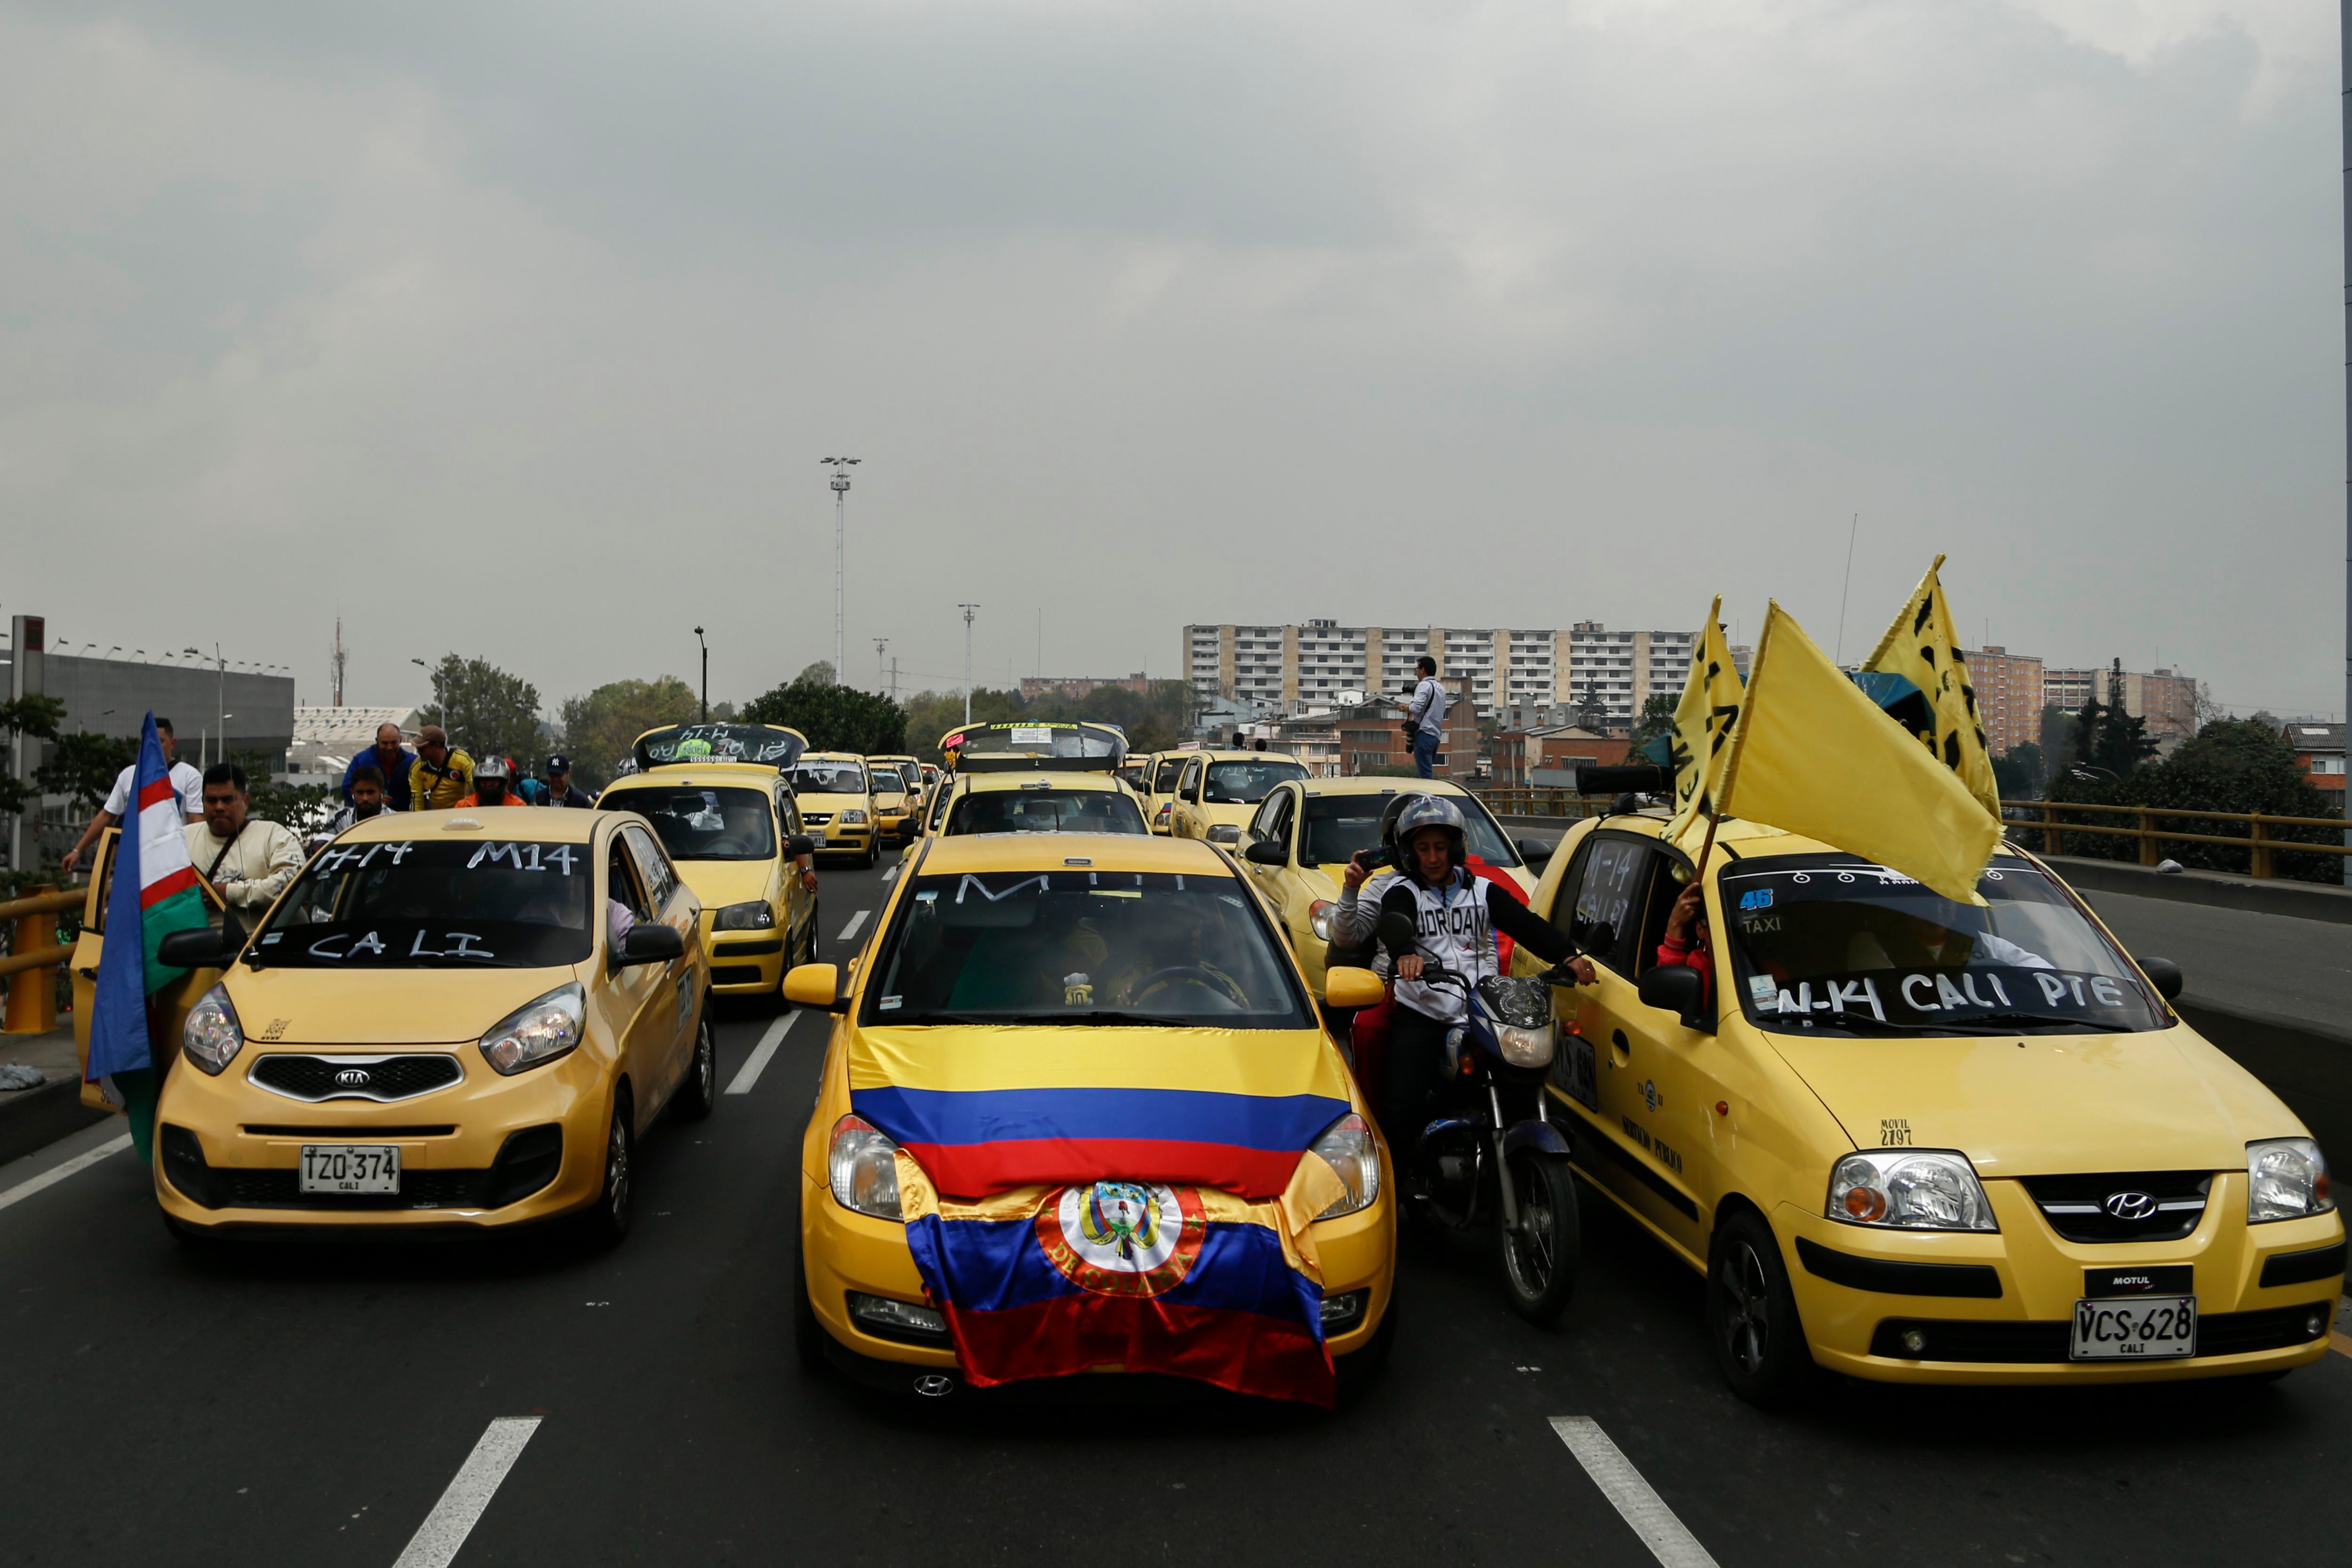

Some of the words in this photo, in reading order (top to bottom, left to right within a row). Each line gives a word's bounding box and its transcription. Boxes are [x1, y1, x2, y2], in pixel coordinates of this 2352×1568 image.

[467, 841, 579, 875] M14
[1740, 888, 1773, 911] 46
[1416, 907, 1486, 937] JORDAN
[1742, 916, 1782, 934] TAXI
[308, 930, 494, 959] CALI
[1072, 992, 1083, 1005] 10
[1902, 972, 2011, 1011] CALI
[2033, 971, 2123, 1007] PTE
[340, 1073, 364, 1083] KIA
[1881, 1119, 1909, 1130] MOVIL
[1880, 1129, 1913, 1146] 2197
[1049, 1241, 1080, 1275] DE
[2113, 1276, 2150, 1285] MOTUL
[2120, 1343, 2145, 1353] CALI
